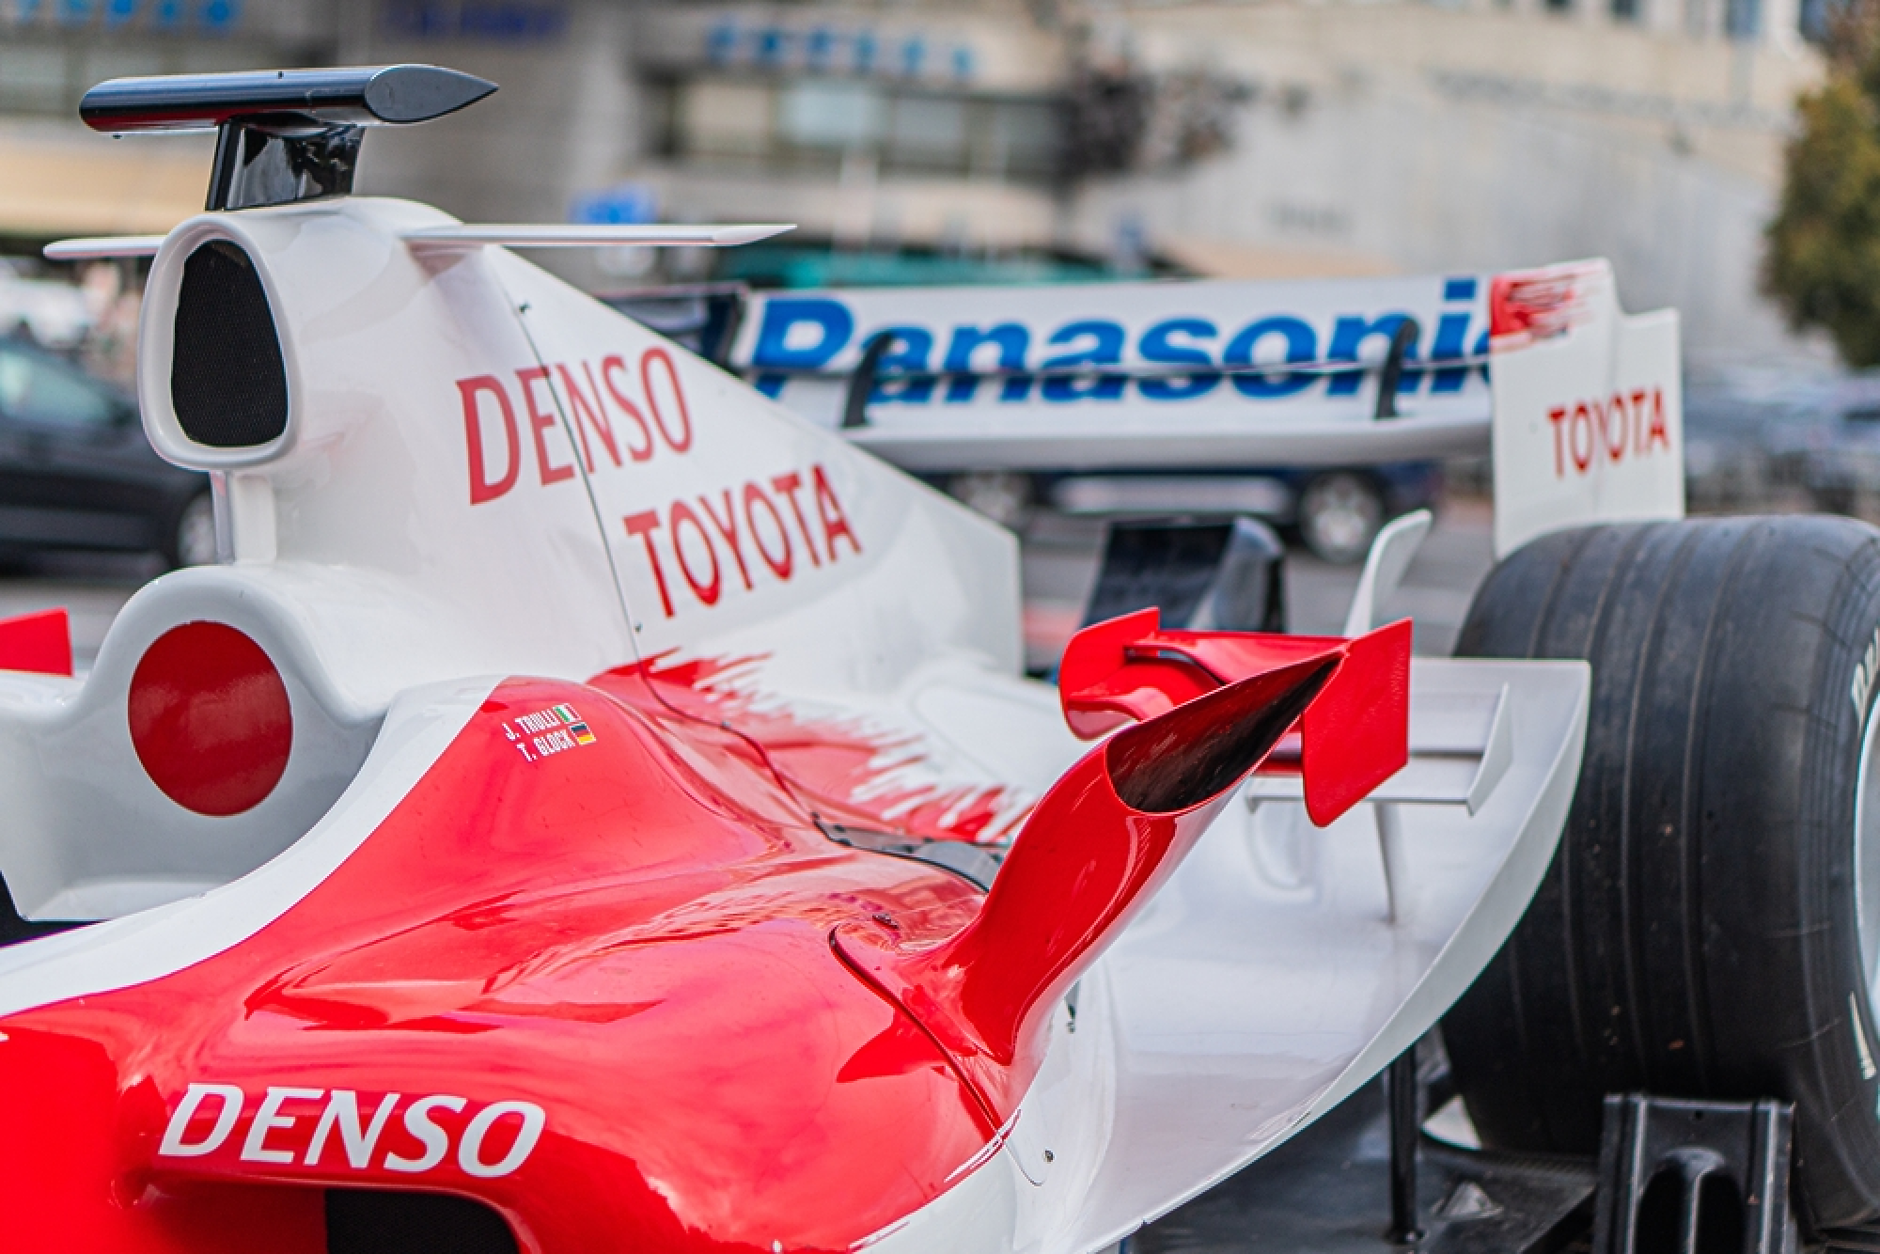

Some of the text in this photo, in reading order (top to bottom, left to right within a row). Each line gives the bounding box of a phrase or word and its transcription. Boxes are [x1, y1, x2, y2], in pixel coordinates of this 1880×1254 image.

[455, 346, 694, 506] DENSO
[1547, 388, 1672, 479] TOYOTA
[622, 463, 864, 620] TOYOTA
[501, 709, 560, 741] J. TRULLI
[516, 730, 575, 762] T. GLOCK
[157, 1081, 547, 1179] DENSO
